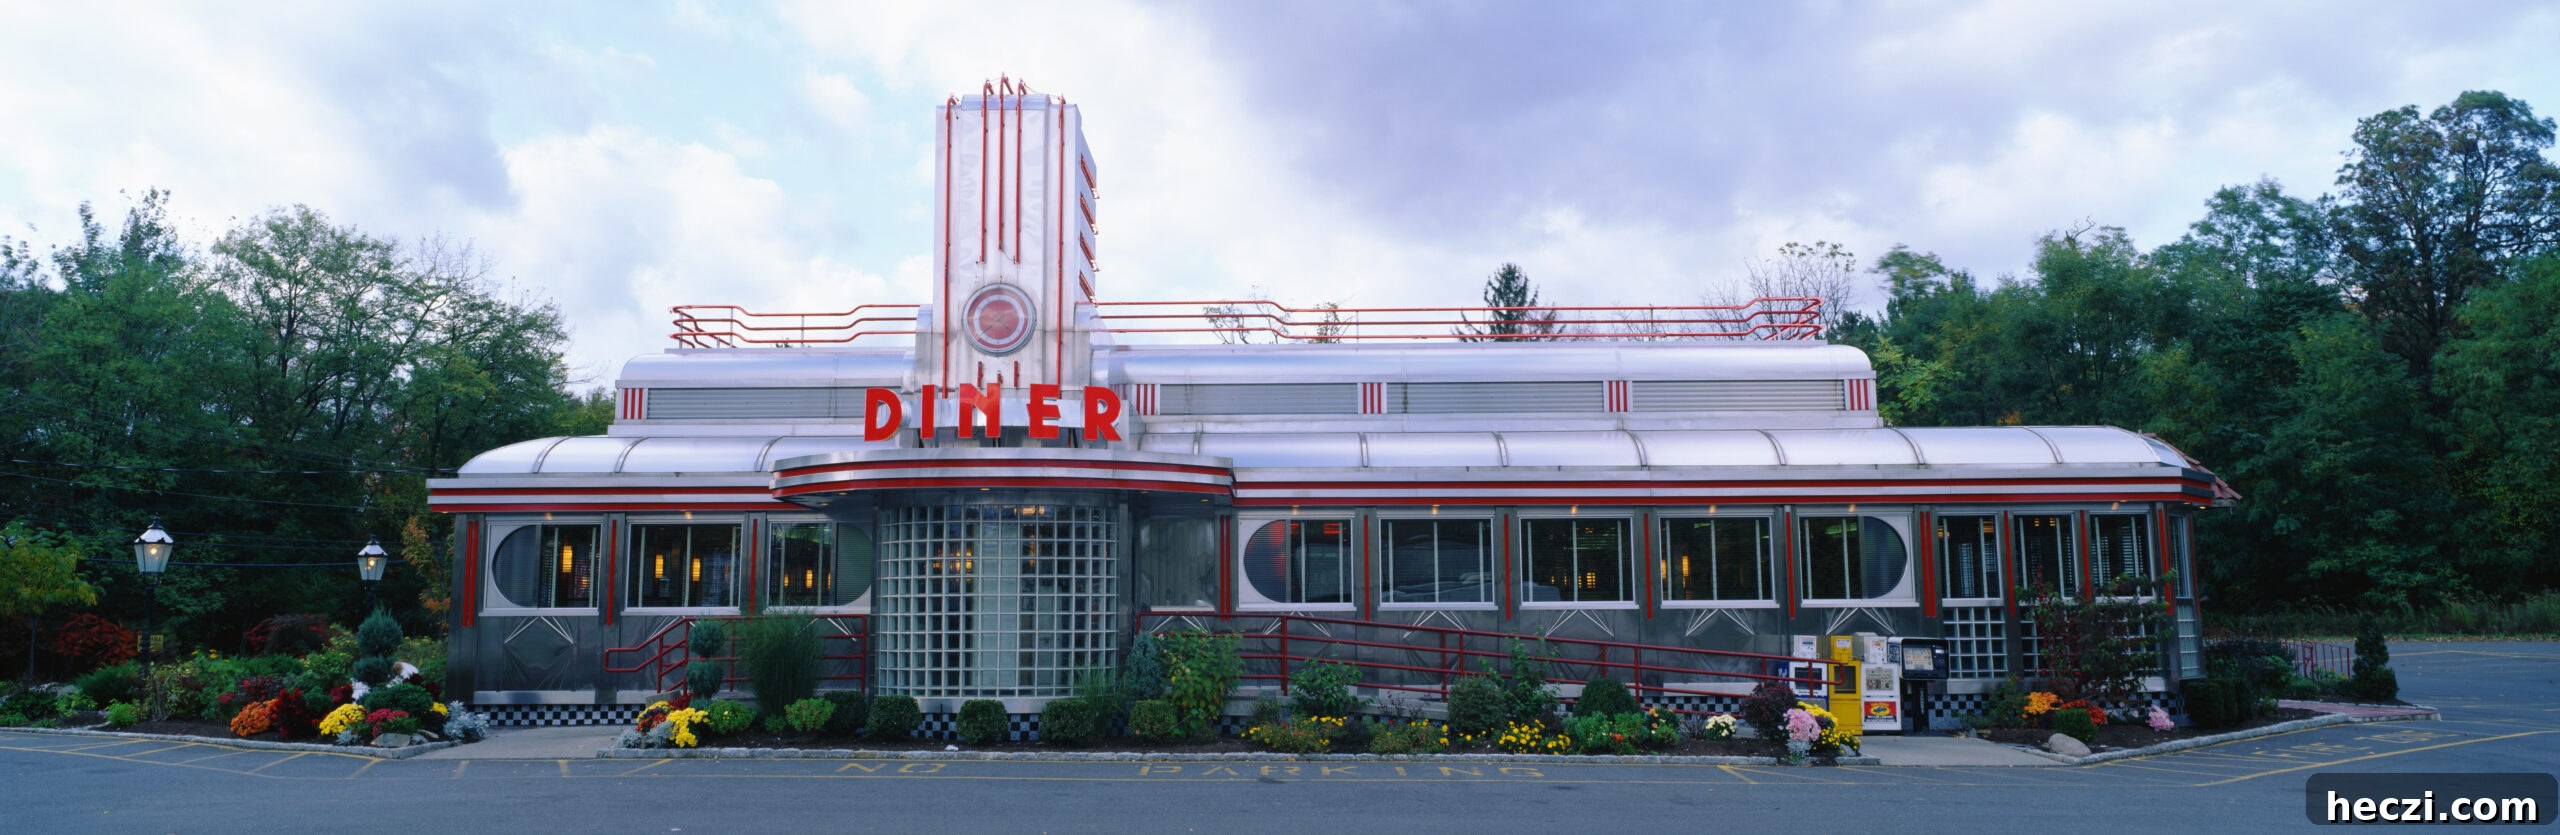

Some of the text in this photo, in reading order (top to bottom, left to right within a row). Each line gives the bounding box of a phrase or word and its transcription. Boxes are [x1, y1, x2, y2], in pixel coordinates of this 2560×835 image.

[864, 383, 1122, 442] DINER
[835, 763, 1546, 778] NO PARKING
